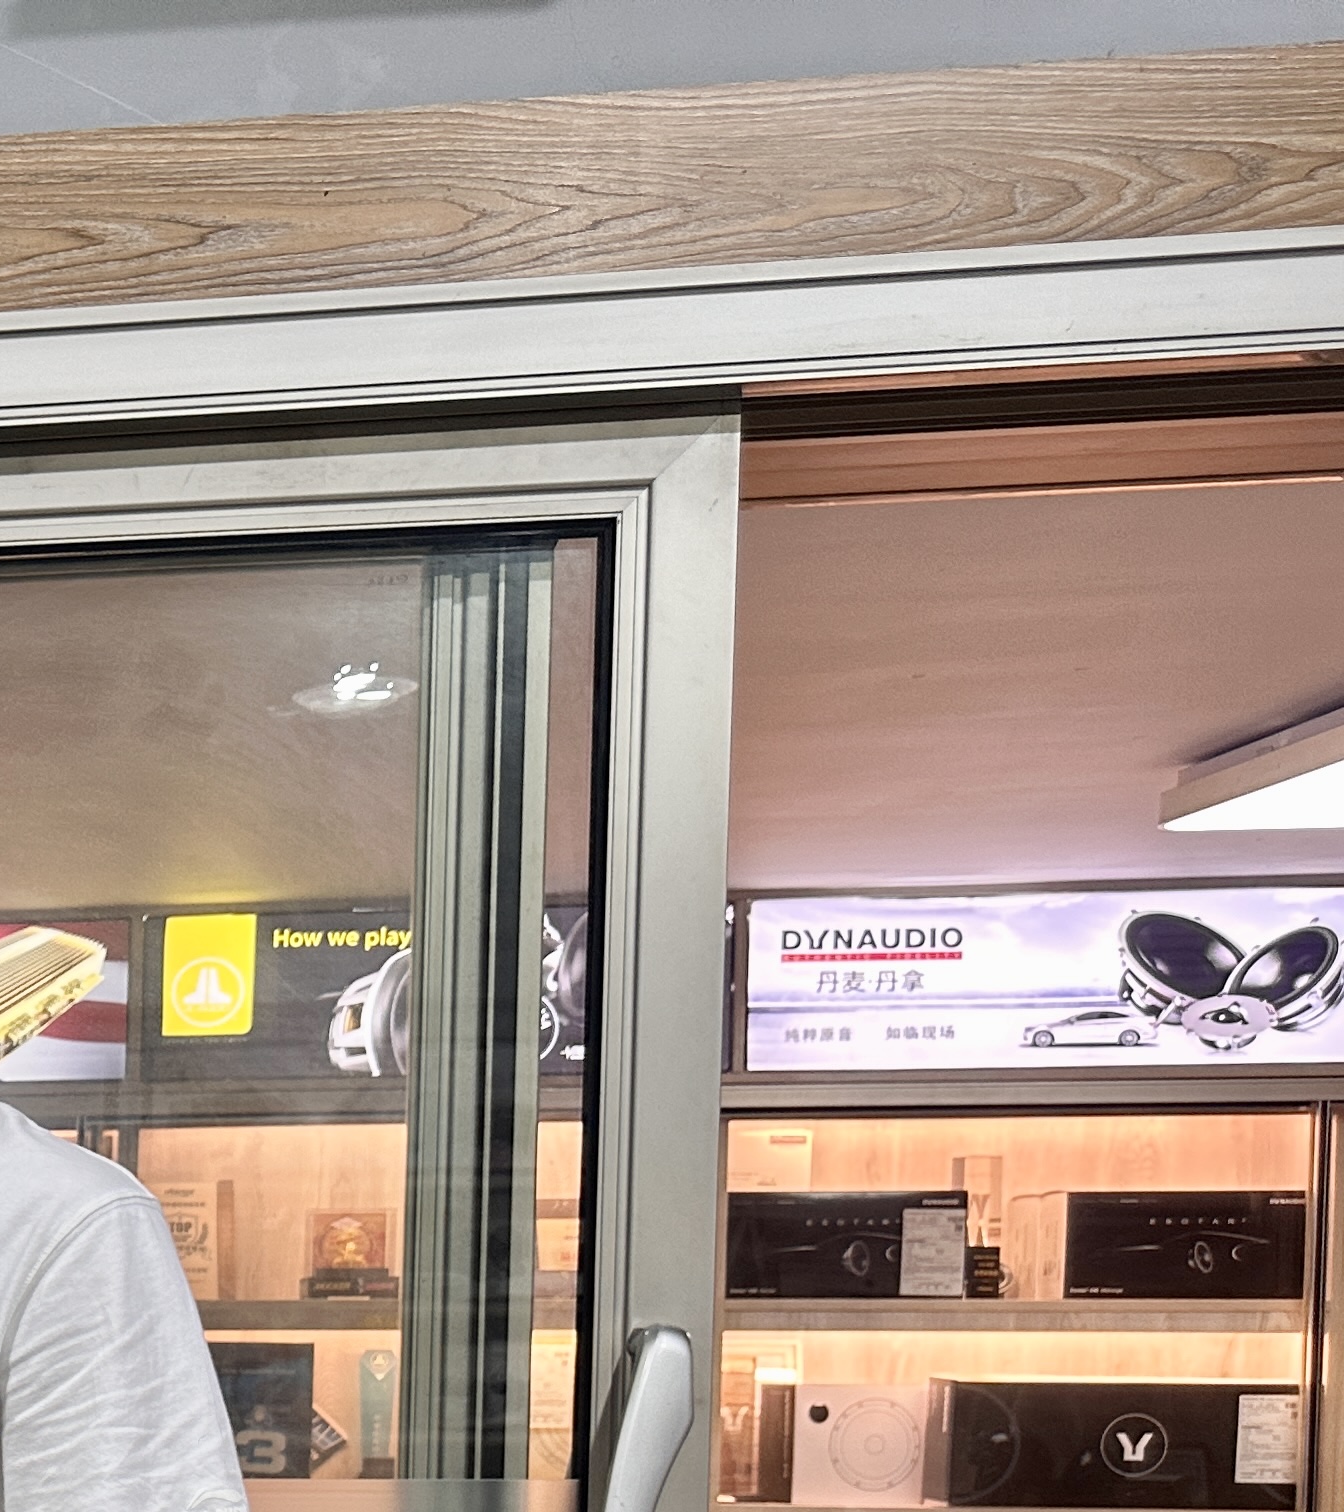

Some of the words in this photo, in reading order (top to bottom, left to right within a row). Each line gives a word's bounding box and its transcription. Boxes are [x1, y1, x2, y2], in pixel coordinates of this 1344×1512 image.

[273, 929, 322, 948] How
[327, 931, 359, 947] we
[364, 926, 412, 951] play
[781, 927, 963, 950] DYNAUDIO
